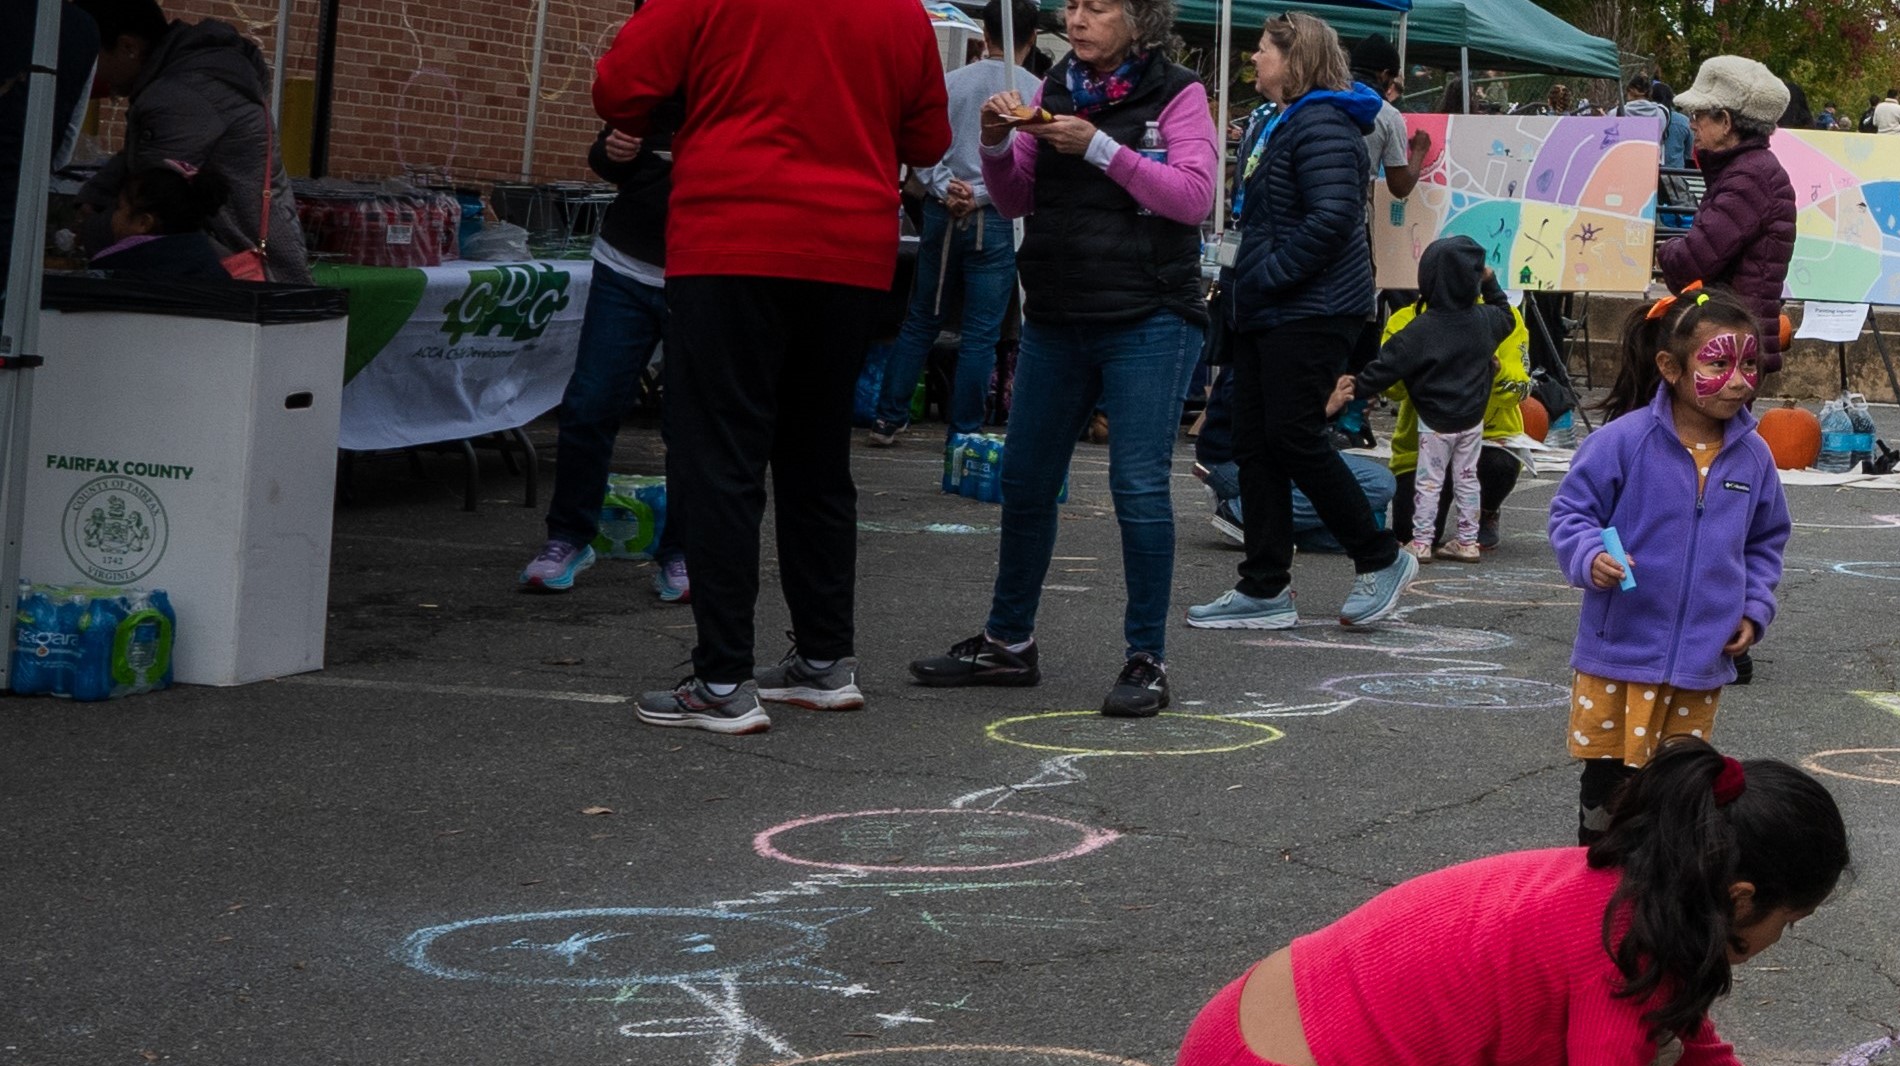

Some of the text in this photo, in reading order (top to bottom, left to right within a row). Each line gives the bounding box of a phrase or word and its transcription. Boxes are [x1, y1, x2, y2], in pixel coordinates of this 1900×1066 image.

[458, 266, 559, 330] CDC
[46, 455, 194, 480] FAIRFAX COUNTY
[102, 556, 123, 565] 1742
[88, 565, 138, 580] VIRGINIA
